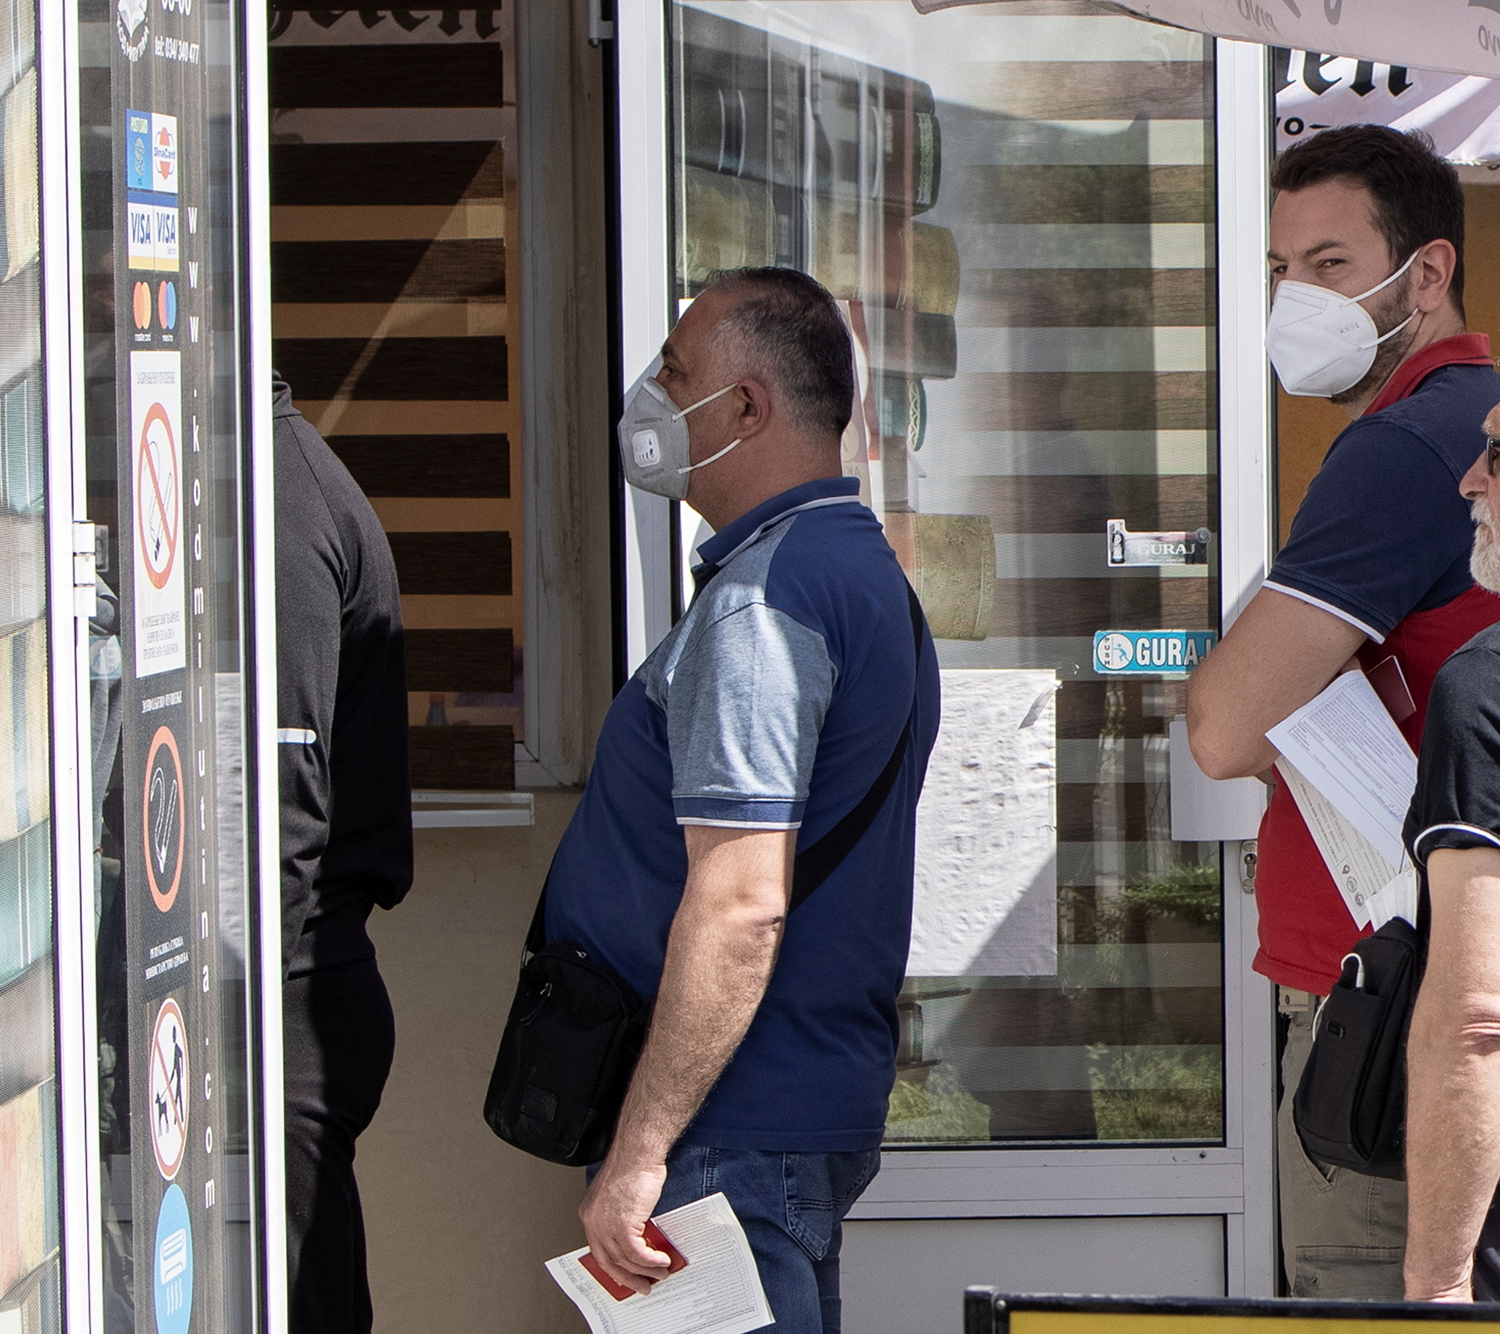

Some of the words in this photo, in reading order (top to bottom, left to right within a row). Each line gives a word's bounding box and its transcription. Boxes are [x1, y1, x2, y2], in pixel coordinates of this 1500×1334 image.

[189, 42, 200, 65] 477
[131, 212, 151, 245] VISA
[157, 212, 176, 245] VISA
